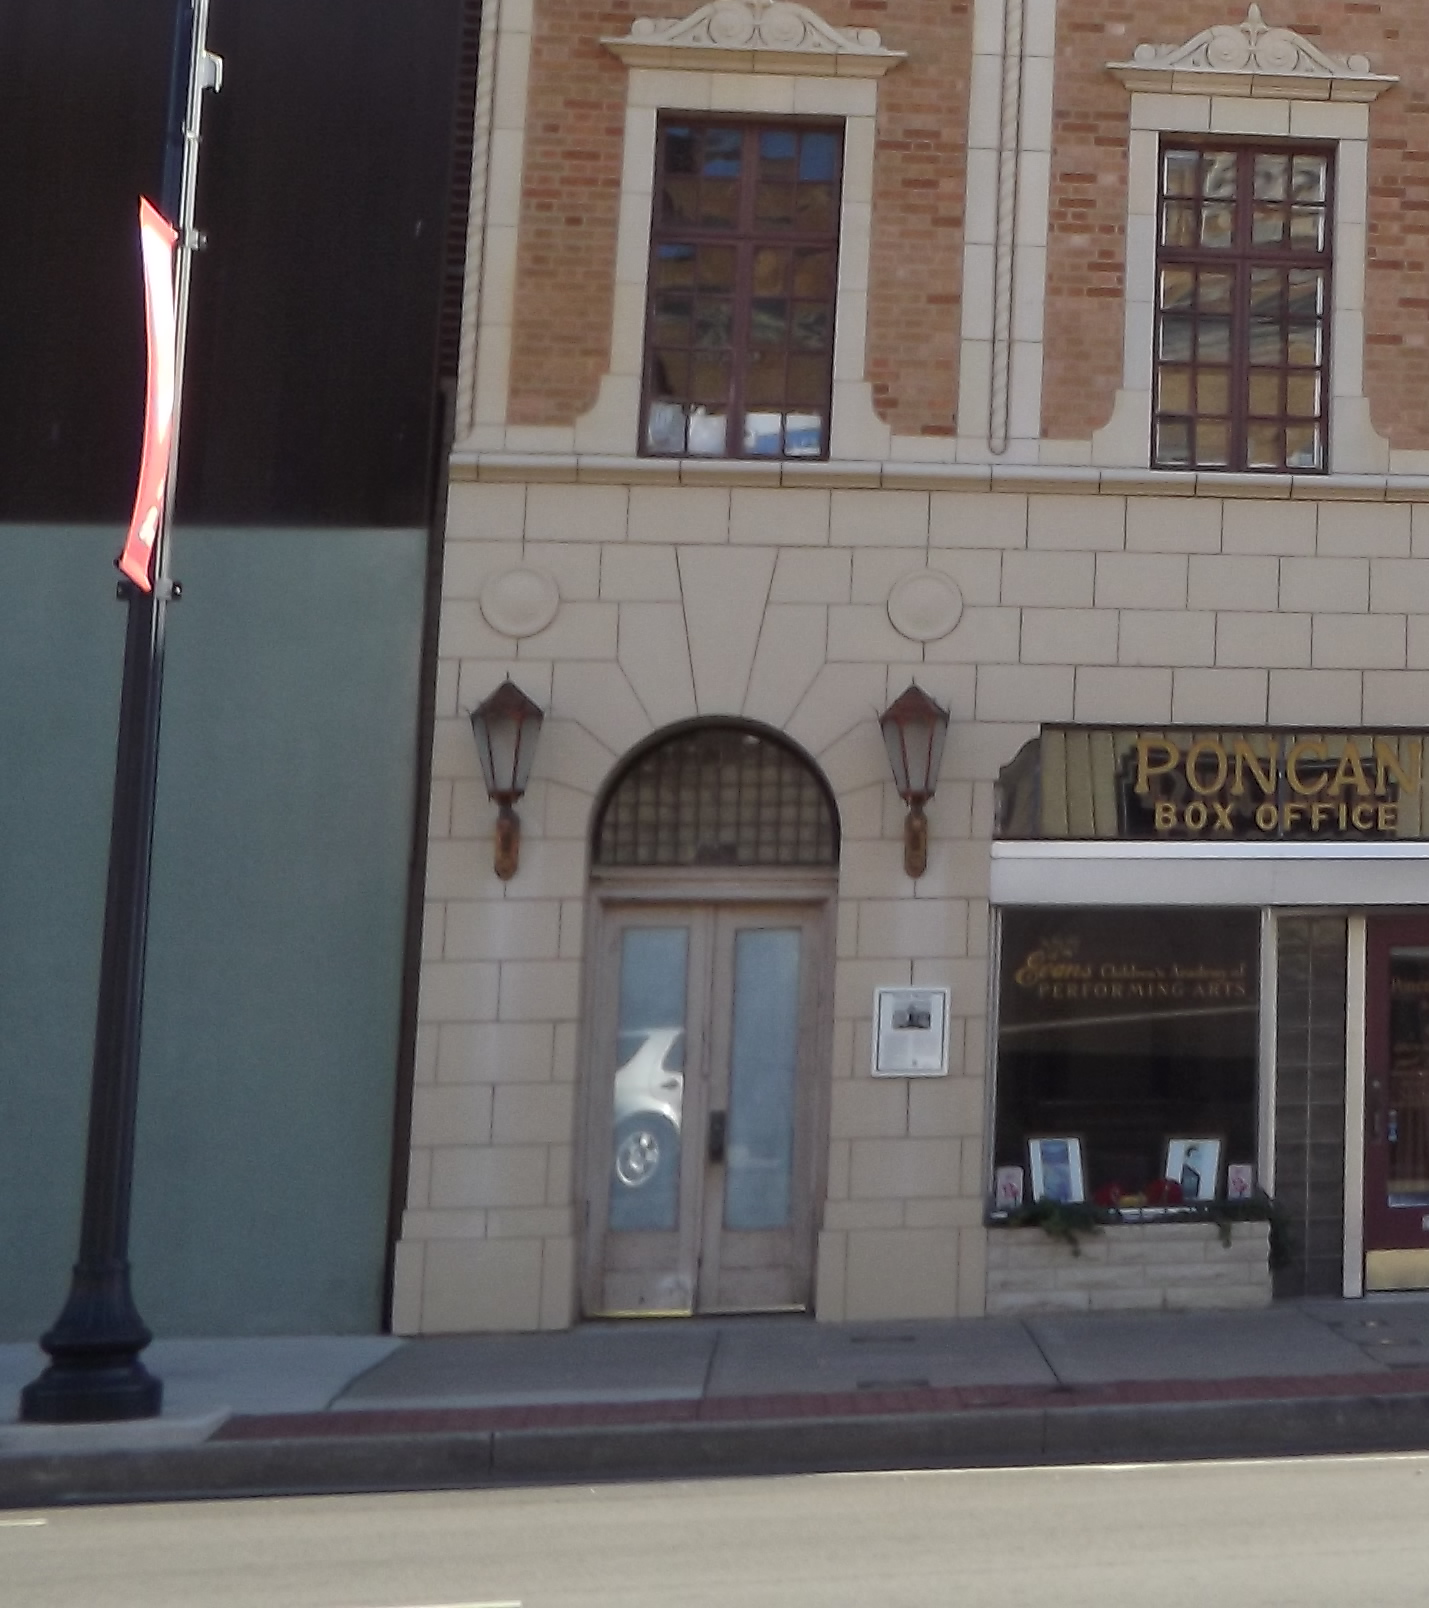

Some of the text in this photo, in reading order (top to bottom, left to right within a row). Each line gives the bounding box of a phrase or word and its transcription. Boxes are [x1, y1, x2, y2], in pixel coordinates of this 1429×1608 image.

[1134, 738, 1423, 796] PONCAN
[1154, 801, 1235, 832] BOX
[1255, 801, 1399, 832] OFFICE
[1038, 982, 1248, 999] PERFORMING ARTS
